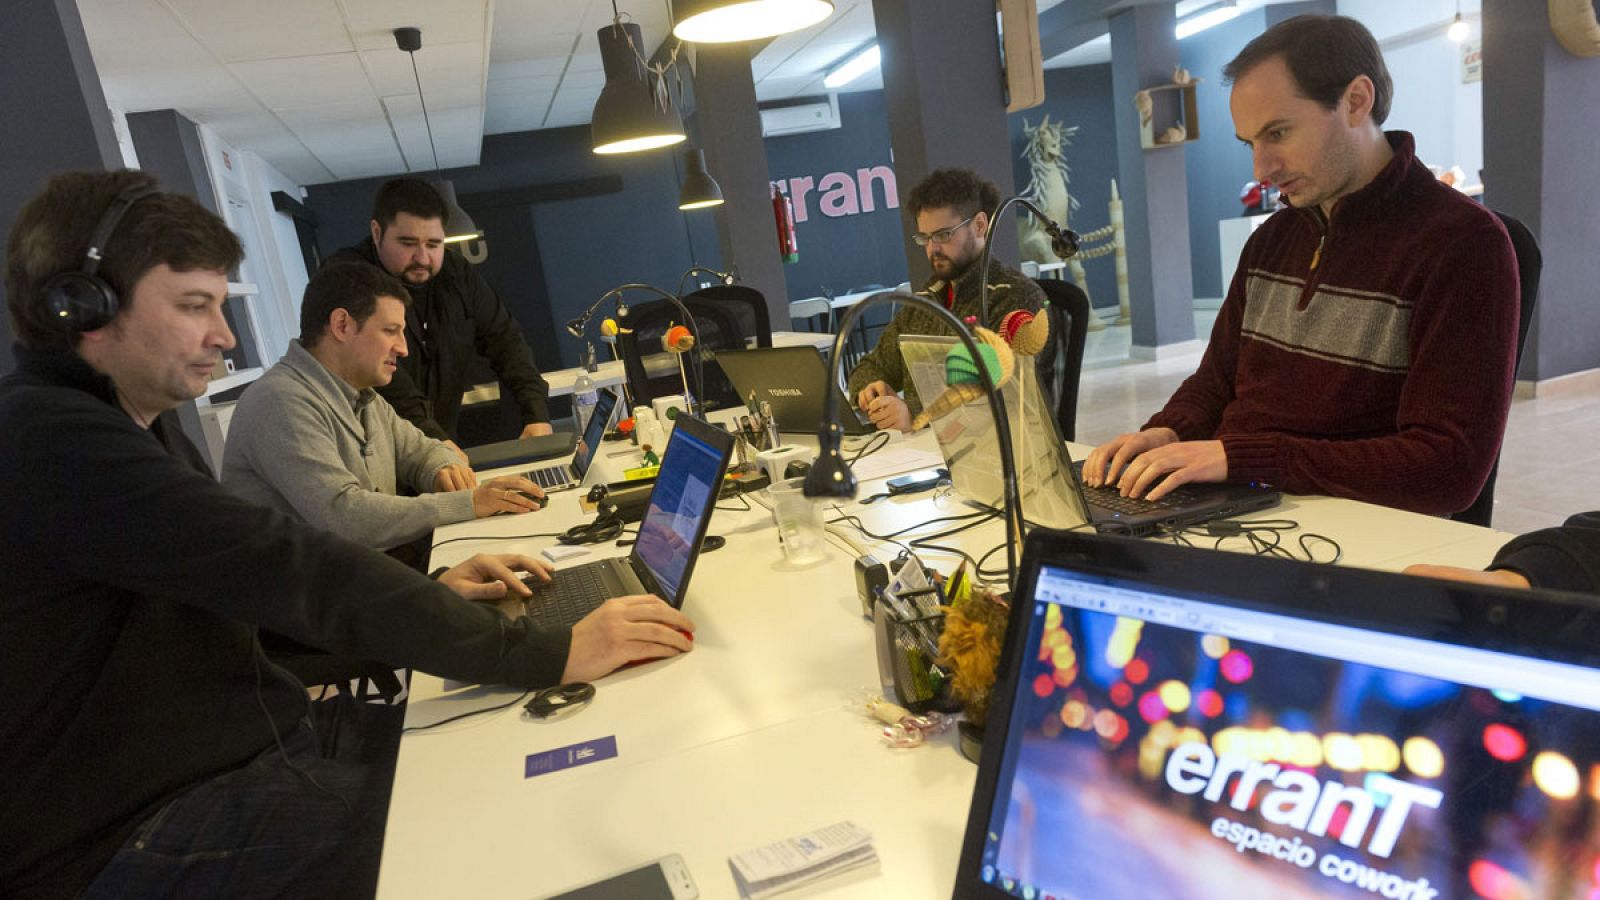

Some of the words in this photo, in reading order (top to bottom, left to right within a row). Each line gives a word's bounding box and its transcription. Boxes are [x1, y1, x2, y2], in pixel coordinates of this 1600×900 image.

[768, 388, 803, 397] TOSHIBA
[1211, 817, 1317, 868] espacio
[1319, 854, 1439, 900] cowork
